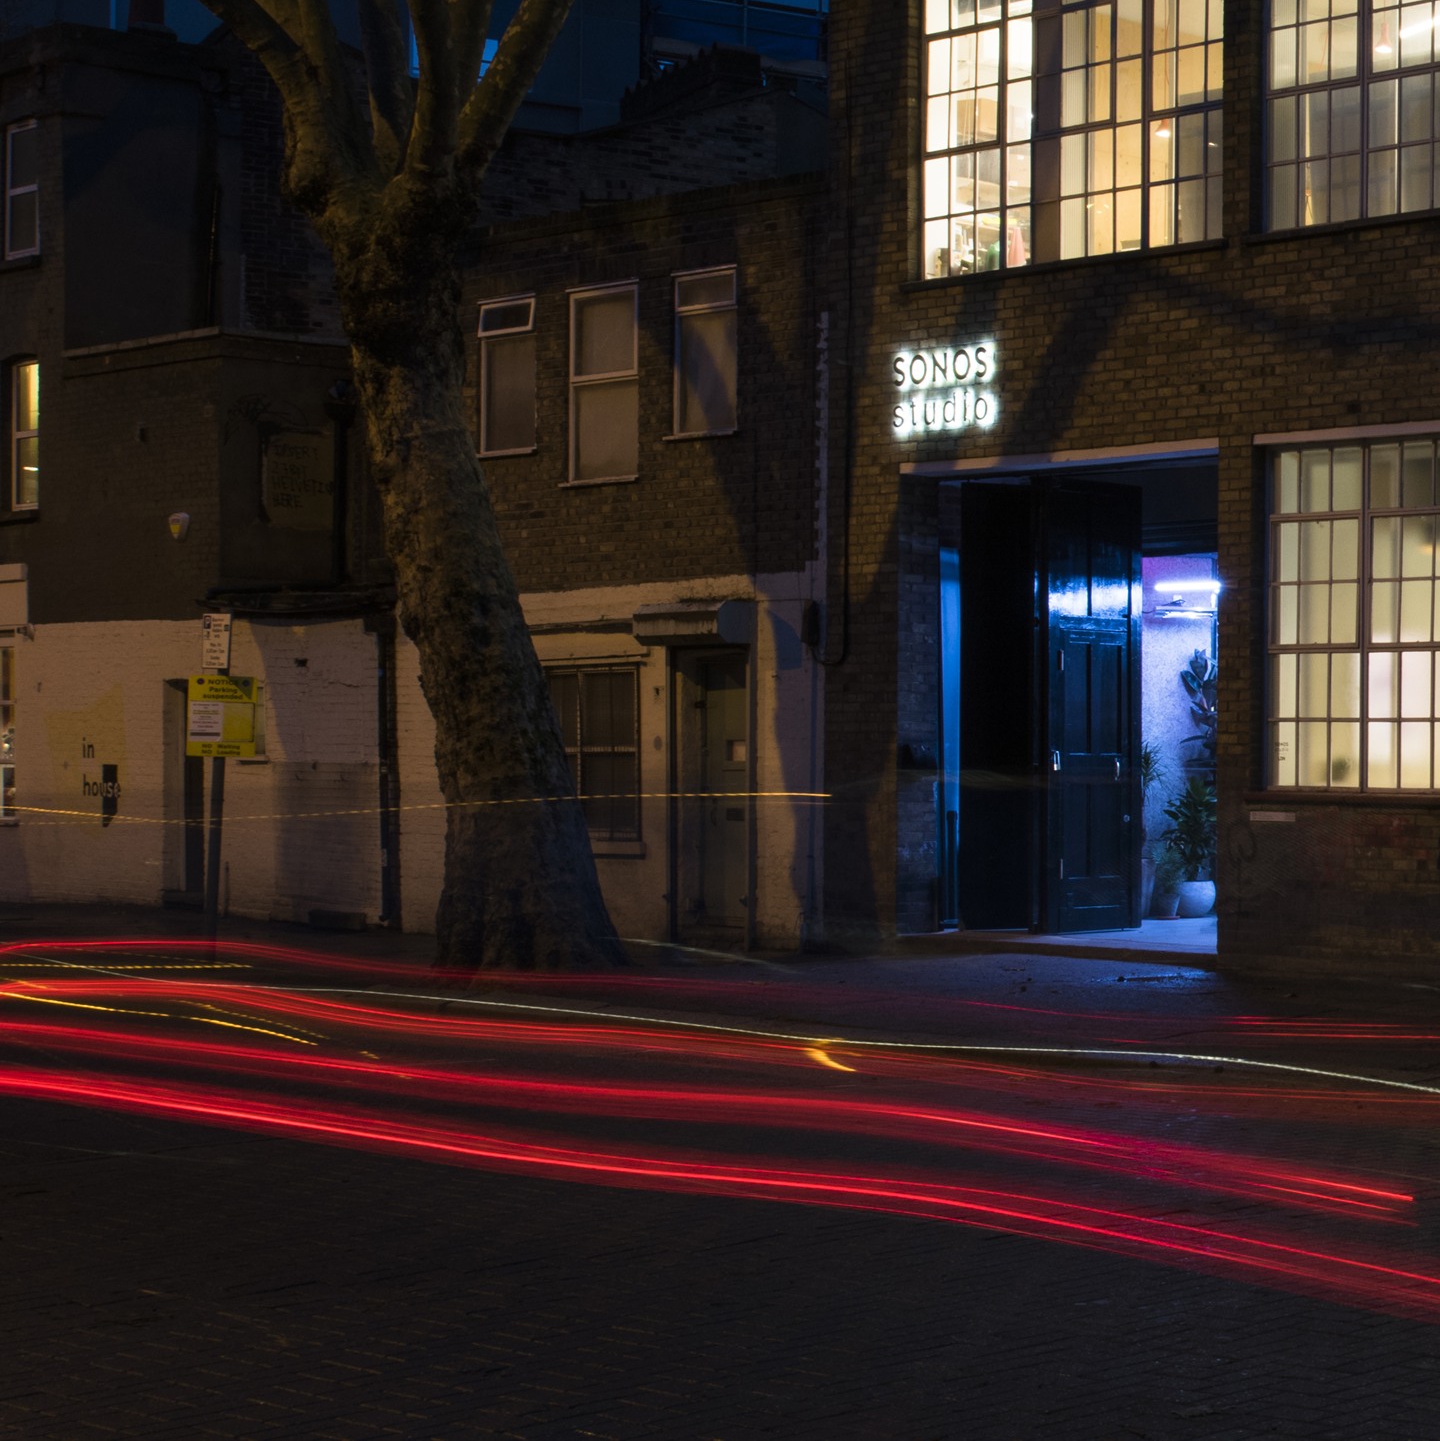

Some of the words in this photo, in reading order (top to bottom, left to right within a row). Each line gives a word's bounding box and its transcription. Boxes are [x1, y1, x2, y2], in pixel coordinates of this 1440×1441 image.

[893, 346, 988, 387] SONOS
[892, 390, 988, 428] studio
[83, 736, 95, 759] in
[83, 773, 121, 799] house
